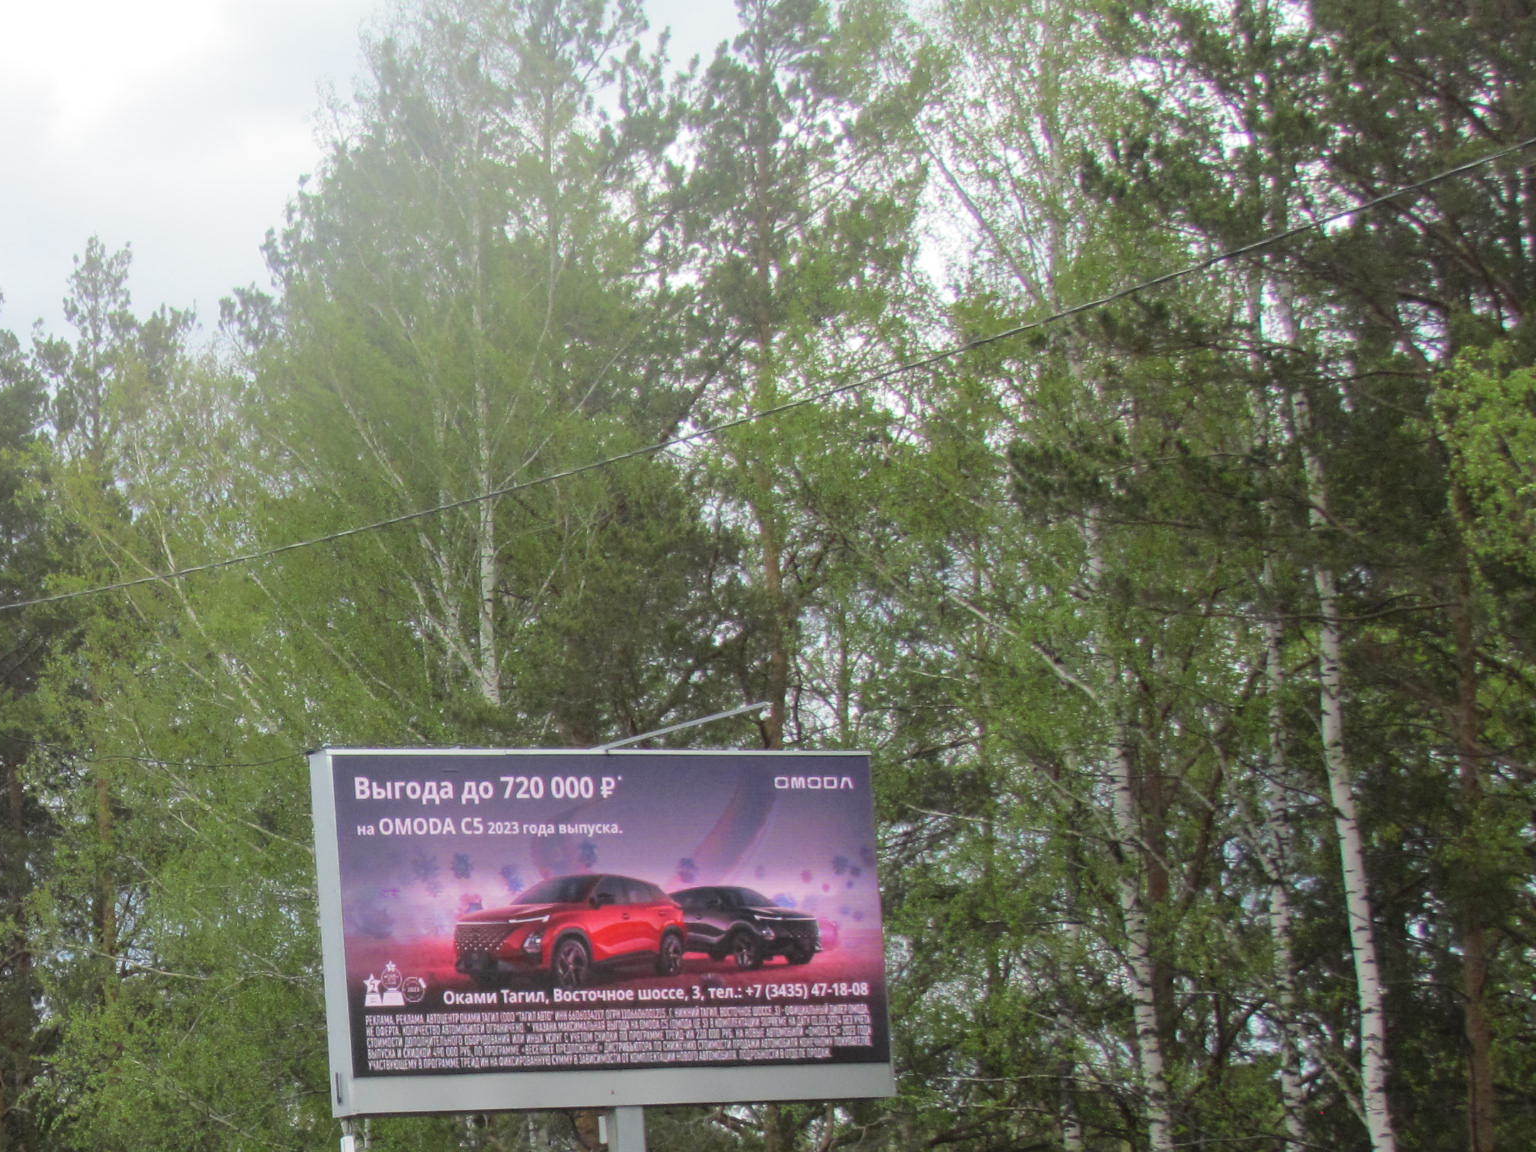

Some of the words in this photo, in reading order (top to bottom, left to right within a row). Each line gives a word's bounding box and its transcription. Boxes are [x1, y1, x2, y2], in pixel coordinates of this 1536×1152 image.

[353, 776, 454, 805] Выгода
[461, 780, 494, 805] до
[500, 776, 545, 799] 720
[550, 776, 594, 799] 000
[357, 824, 375, 836] на
[378, 817, 456, 836] OMODA
[461, 817, 484, 836] C5
[487, 821, 520, 835] 2023
[522, 824, 555, 837] года
[558, 823, 623, 838] выпуска.
[443, 990, 497, 1006] Оками
[500, 988, 550, 1006] Тагил,
[553, 987, 634, 1004] Восточное
[637, 988, 688, 1002] шоссе,
[691, 985, 705, 1002] 3,
[708, 986, 742, 1000] тел.:
[745, 984, 762, 999] +7
[765, 982, 808, 1001] (3435)
[811, 982, 870, 998] 47-18-08
